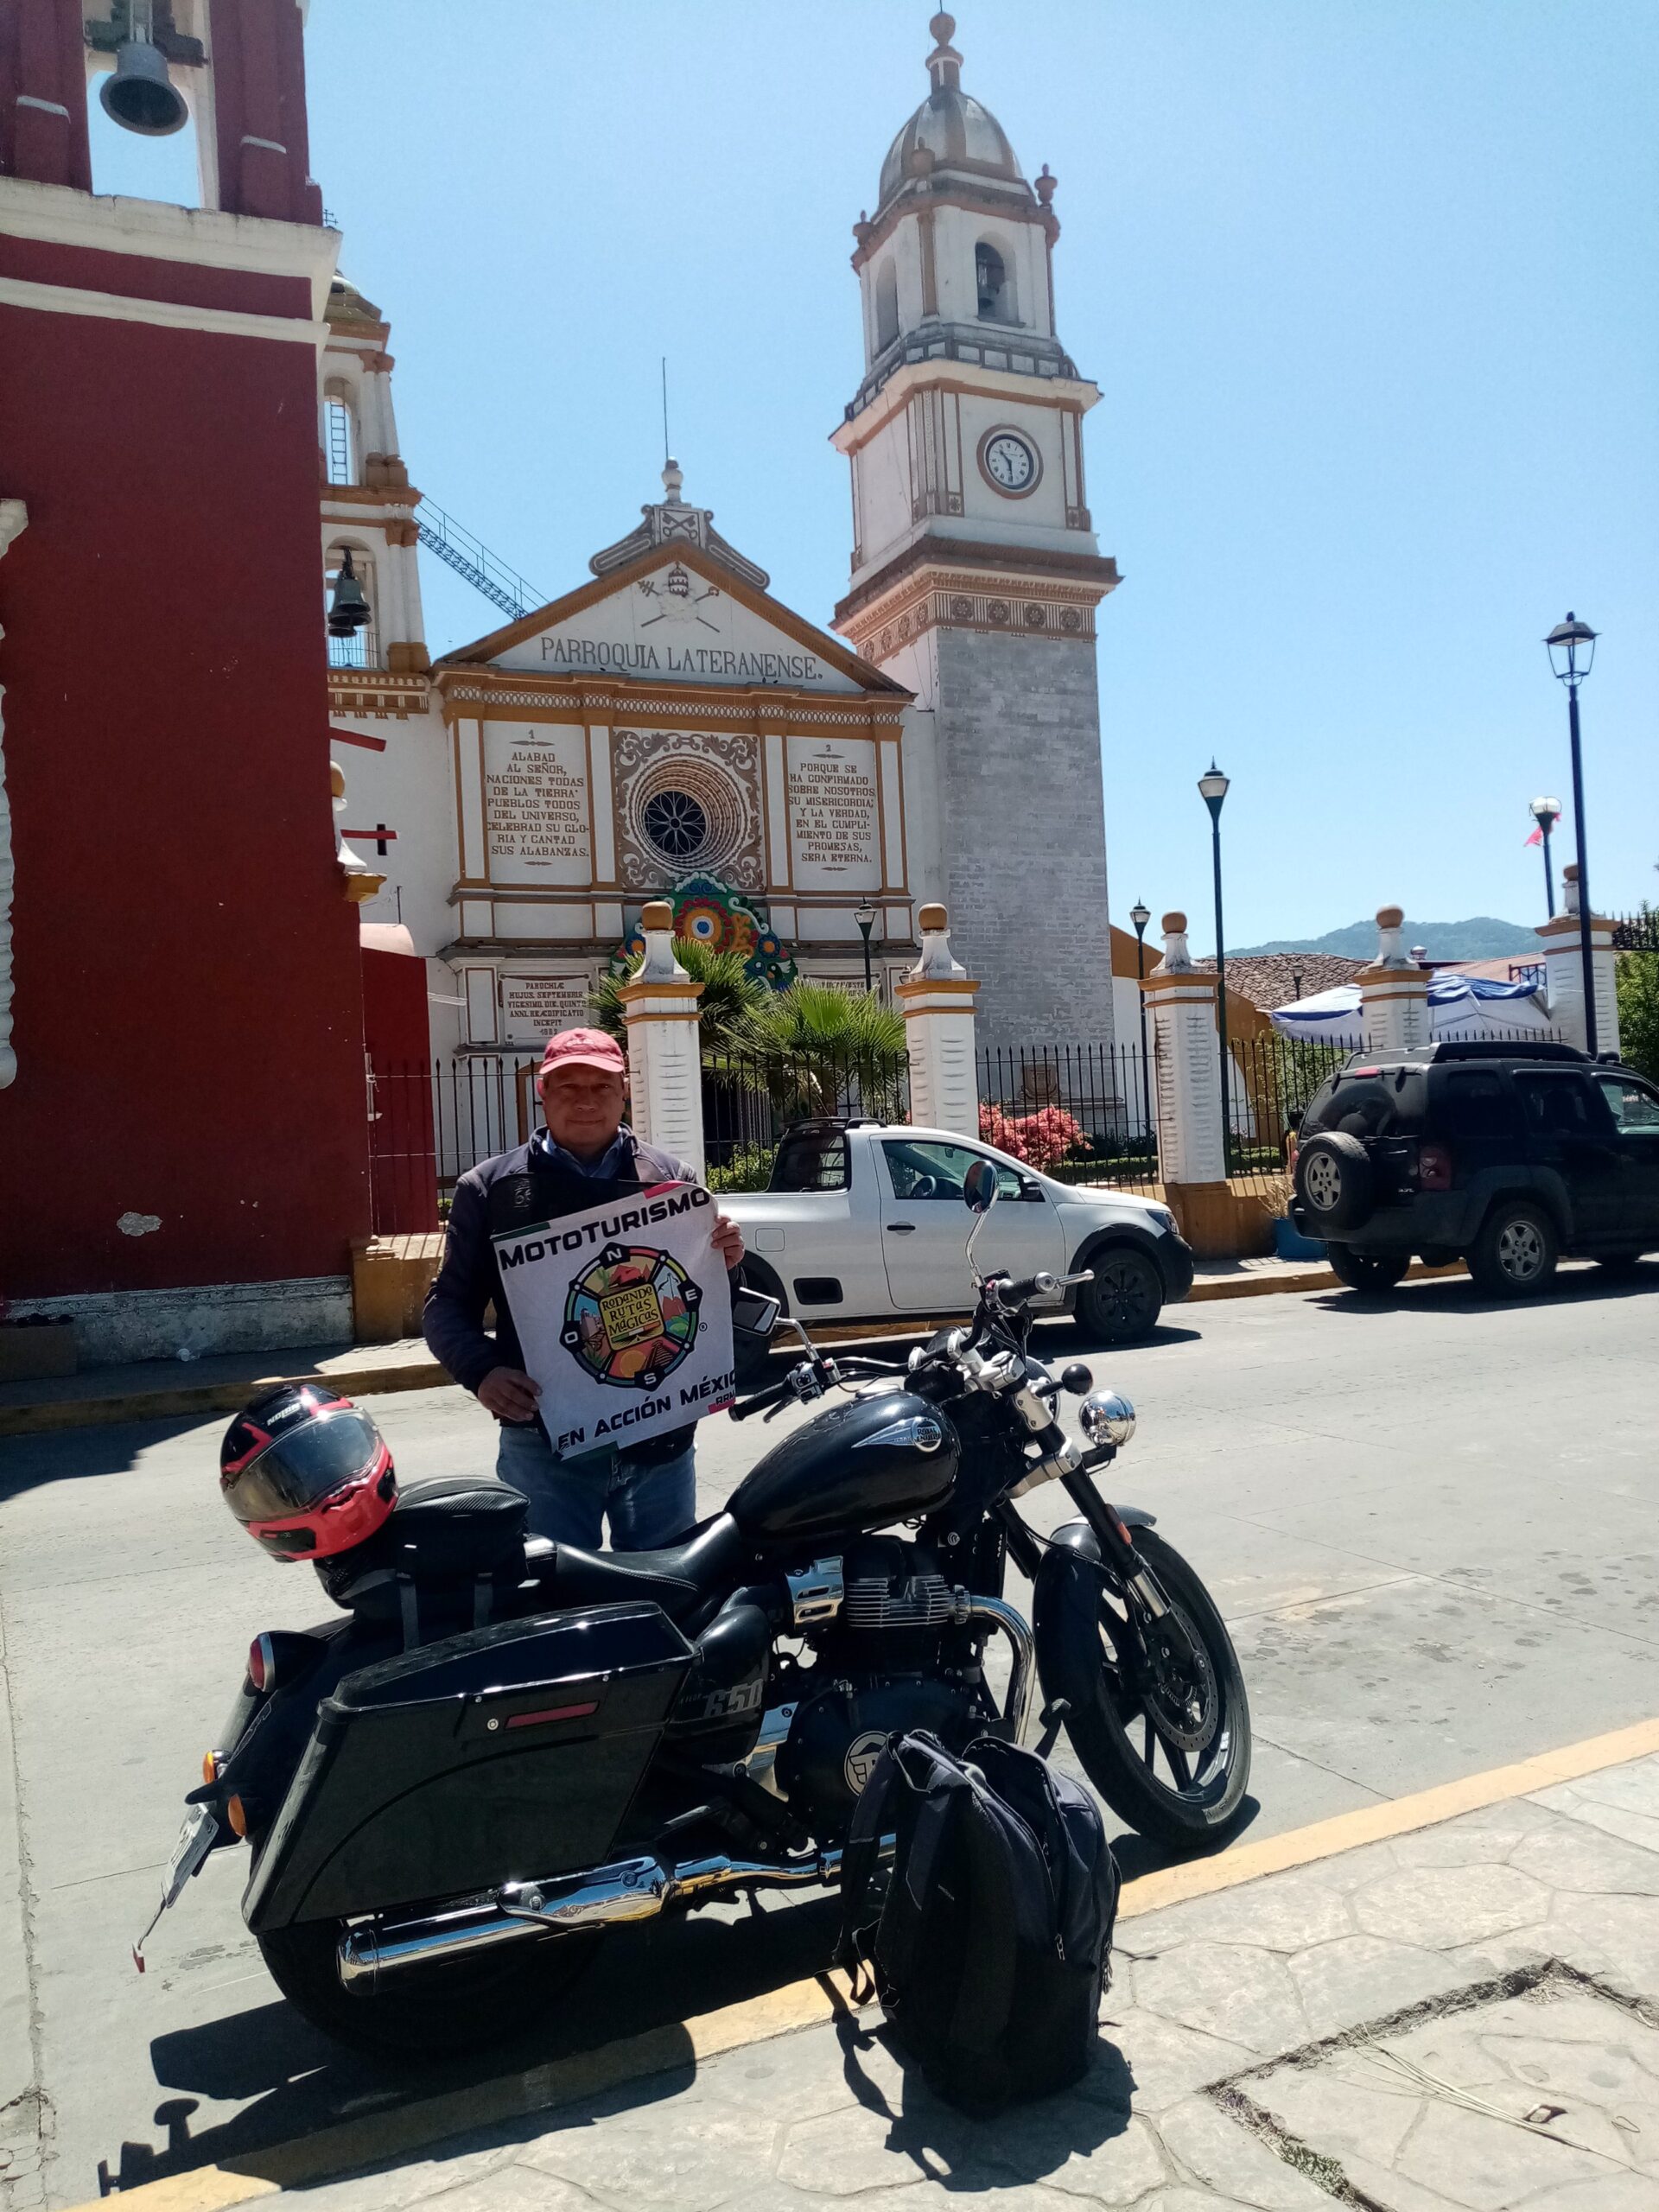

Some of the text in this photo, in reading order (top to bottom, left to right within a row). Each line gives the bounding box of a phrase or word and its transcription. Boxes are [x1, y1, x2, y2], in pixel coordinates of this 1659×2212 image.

[541, 637, 823, 679] PARROQUIA LATERANENSE.
[528, 729, 536, 739] 1
[512, 752, 556, 762] ALABAD
[506, 762, 567, 776] AL SEÑOR,
[800, 763, 857, 774] PORQUE SE
[486, 774, 584, 787] NACIONES TODAS
[789, 773, 868, 785] HA CONFIRMADO
[493, 786, 508, 796] DE
[514, 787, 528, 797] LA
[788, 785, 875, 797] SOBRE NOSOTROS
[487, 798, 581, 810] PUEBLOS TODOS
[788, 796, 801, 805] SU
[493, 810, 579, 823] DEL UNIVERSO,
[800, 808, 870, 819] Y LA VERDAD,
[486, 822, 542, 832] CELEBRAD
[546, 823, 560, 832] SU
[796, 819, 870, 830] EN EL CUMPLI-
[497, 834, 575, 844] RIA Y CANTAD
[796, 830, 872, 841] MIENTO DE SUS
[491, 845, 589, 857] SUS ALABANZAS.
[808, 842, 862, 853] PROMESAS,
[801, 853, 872, 863] SERA ETERNA.
[499, 1188, 710, 1271] MOTOTURISMO
[607, 1248, 622, 1262] N
[685, 1288, 698, 1301] E
[564, 1331, 578, 1344] O
[644, 1372, 657, 1384] S
[557, 1427, 585, 1451] EN
[594, 1396, 671, 1438] ACCIÓN
[704, 1679, 764, 1719] 650
